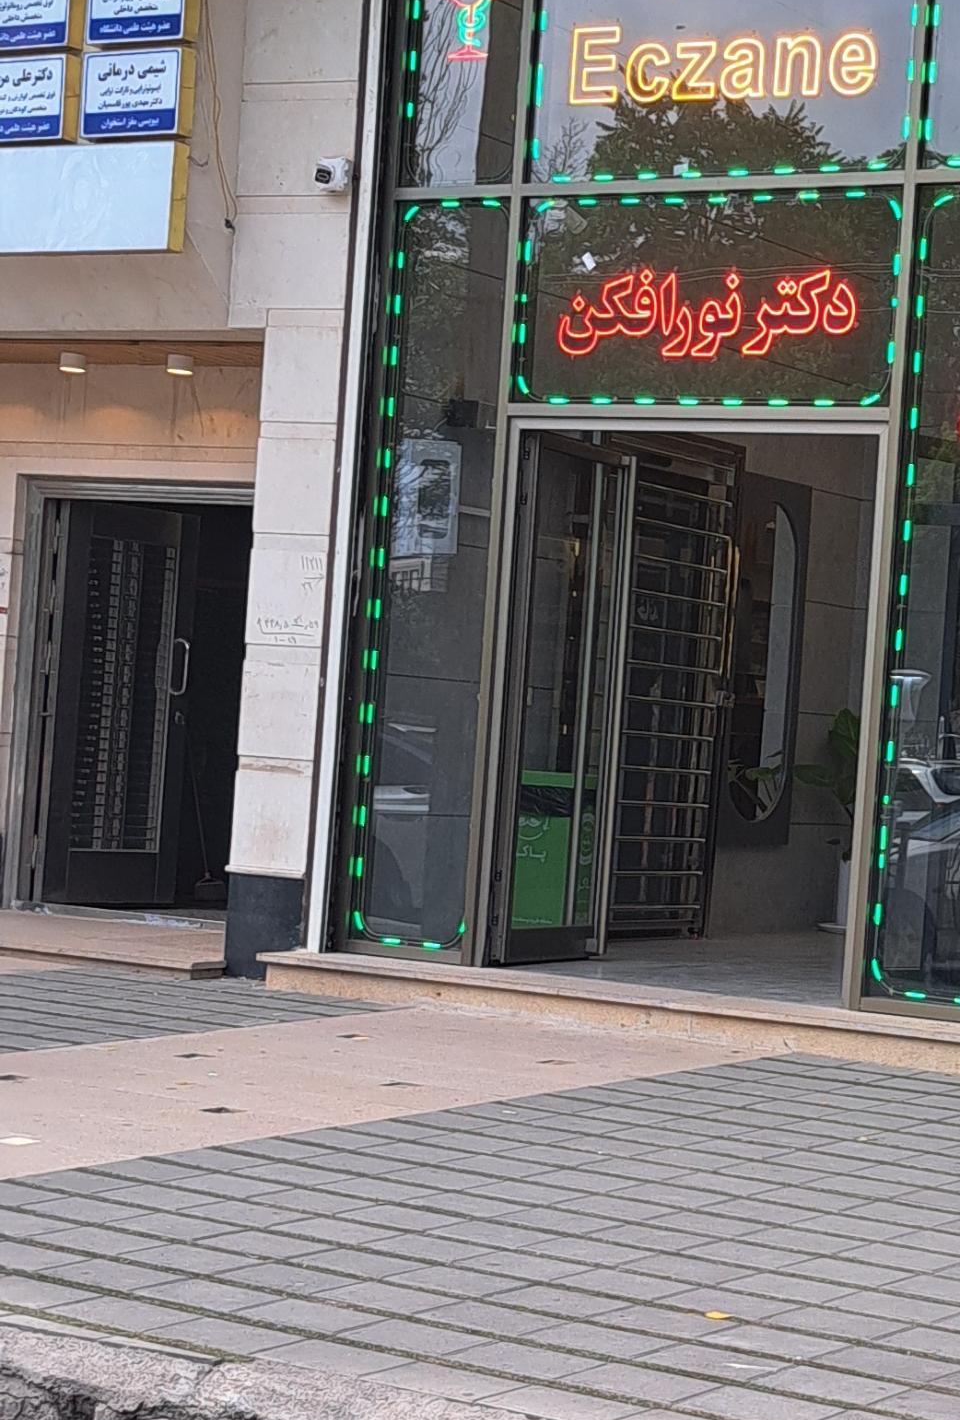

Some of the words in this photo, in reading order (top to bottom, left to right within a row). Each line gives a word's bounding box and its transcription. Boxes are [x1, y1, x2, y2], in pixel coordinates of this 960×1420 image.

[98, 62, 135, 82] درمانی
[138, 59, 167, 79] شیمی
[567, 25, 879, 107] Eczane
[31, 67, 53, 86] دکتر
[742, 266, 858, 358] دکتر
